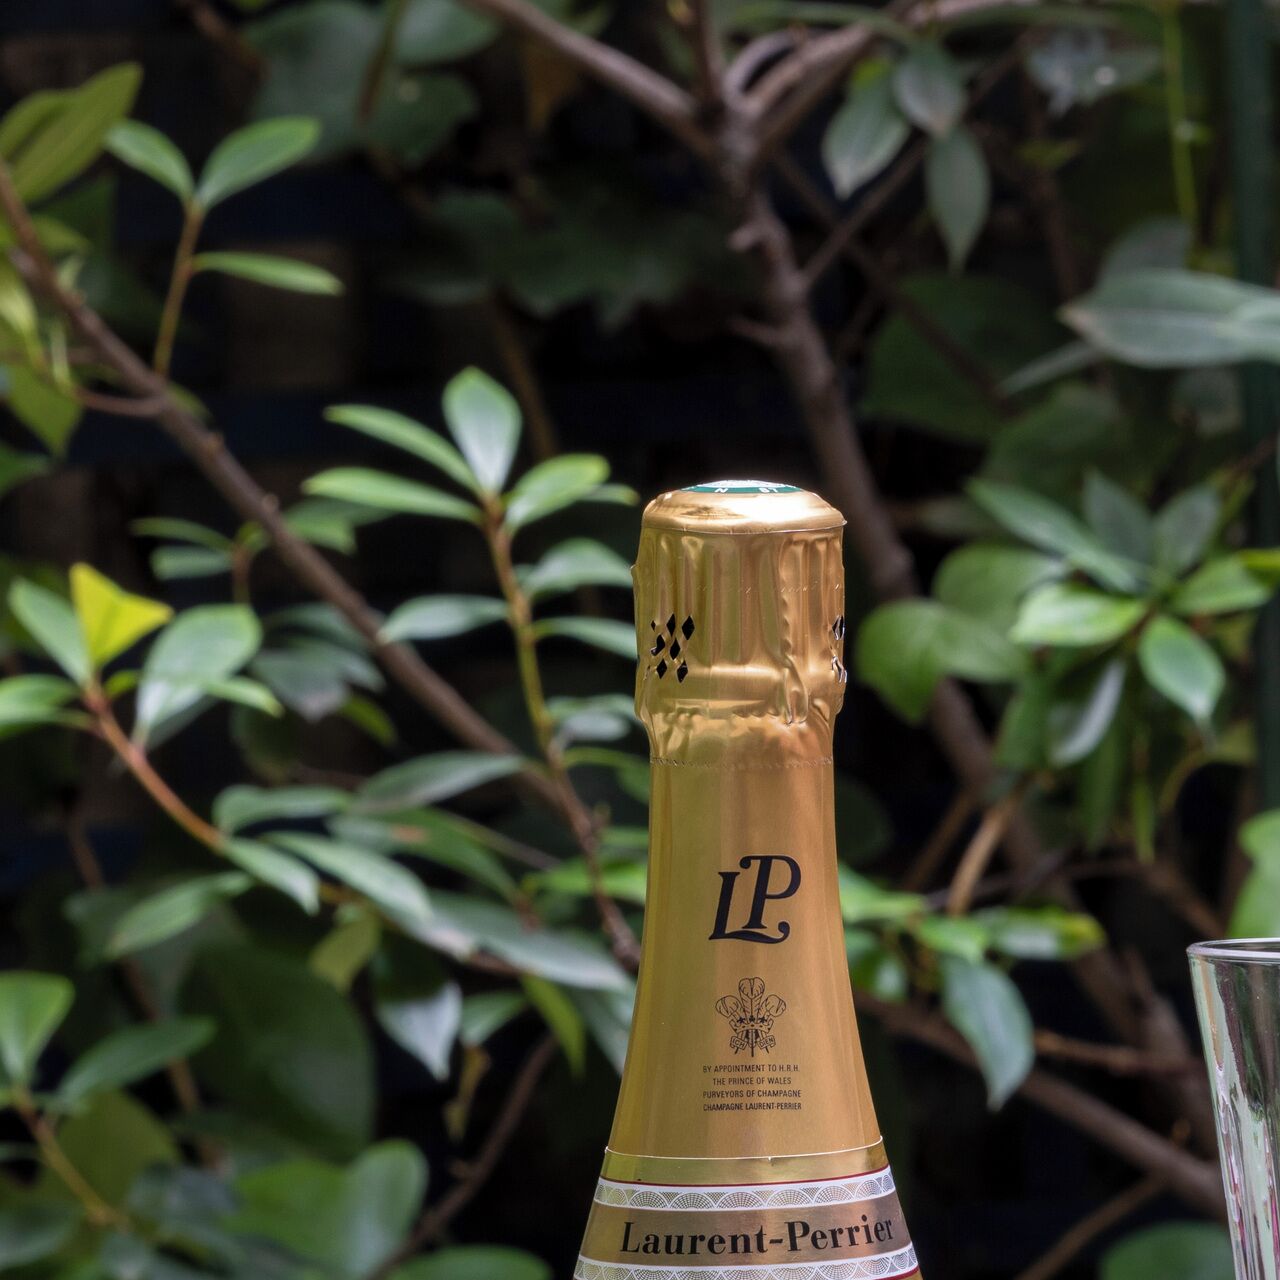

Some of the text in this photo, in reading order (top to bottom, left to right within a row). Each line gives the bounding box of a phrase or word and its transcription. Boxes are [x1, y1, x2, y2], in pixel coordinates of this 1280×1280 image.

[708, 854, 801, 945] LP
[703, 1065, 712, 1073] BY
[714, 1064, 766, 1073] APPOINTMENT
[768, 1064, 777, 1072] TO
[713, 1077, 792, 1086] THE PRINCE OF WALES
[703, 1089, 802, 1099] PURVEYORS OF CHAMPAGNE
[703, 1102, 802, 1112] CHAMPAGNE LAURENT-PERRIER
[620, 1214, 893, 1256] Laurent-Perrier
